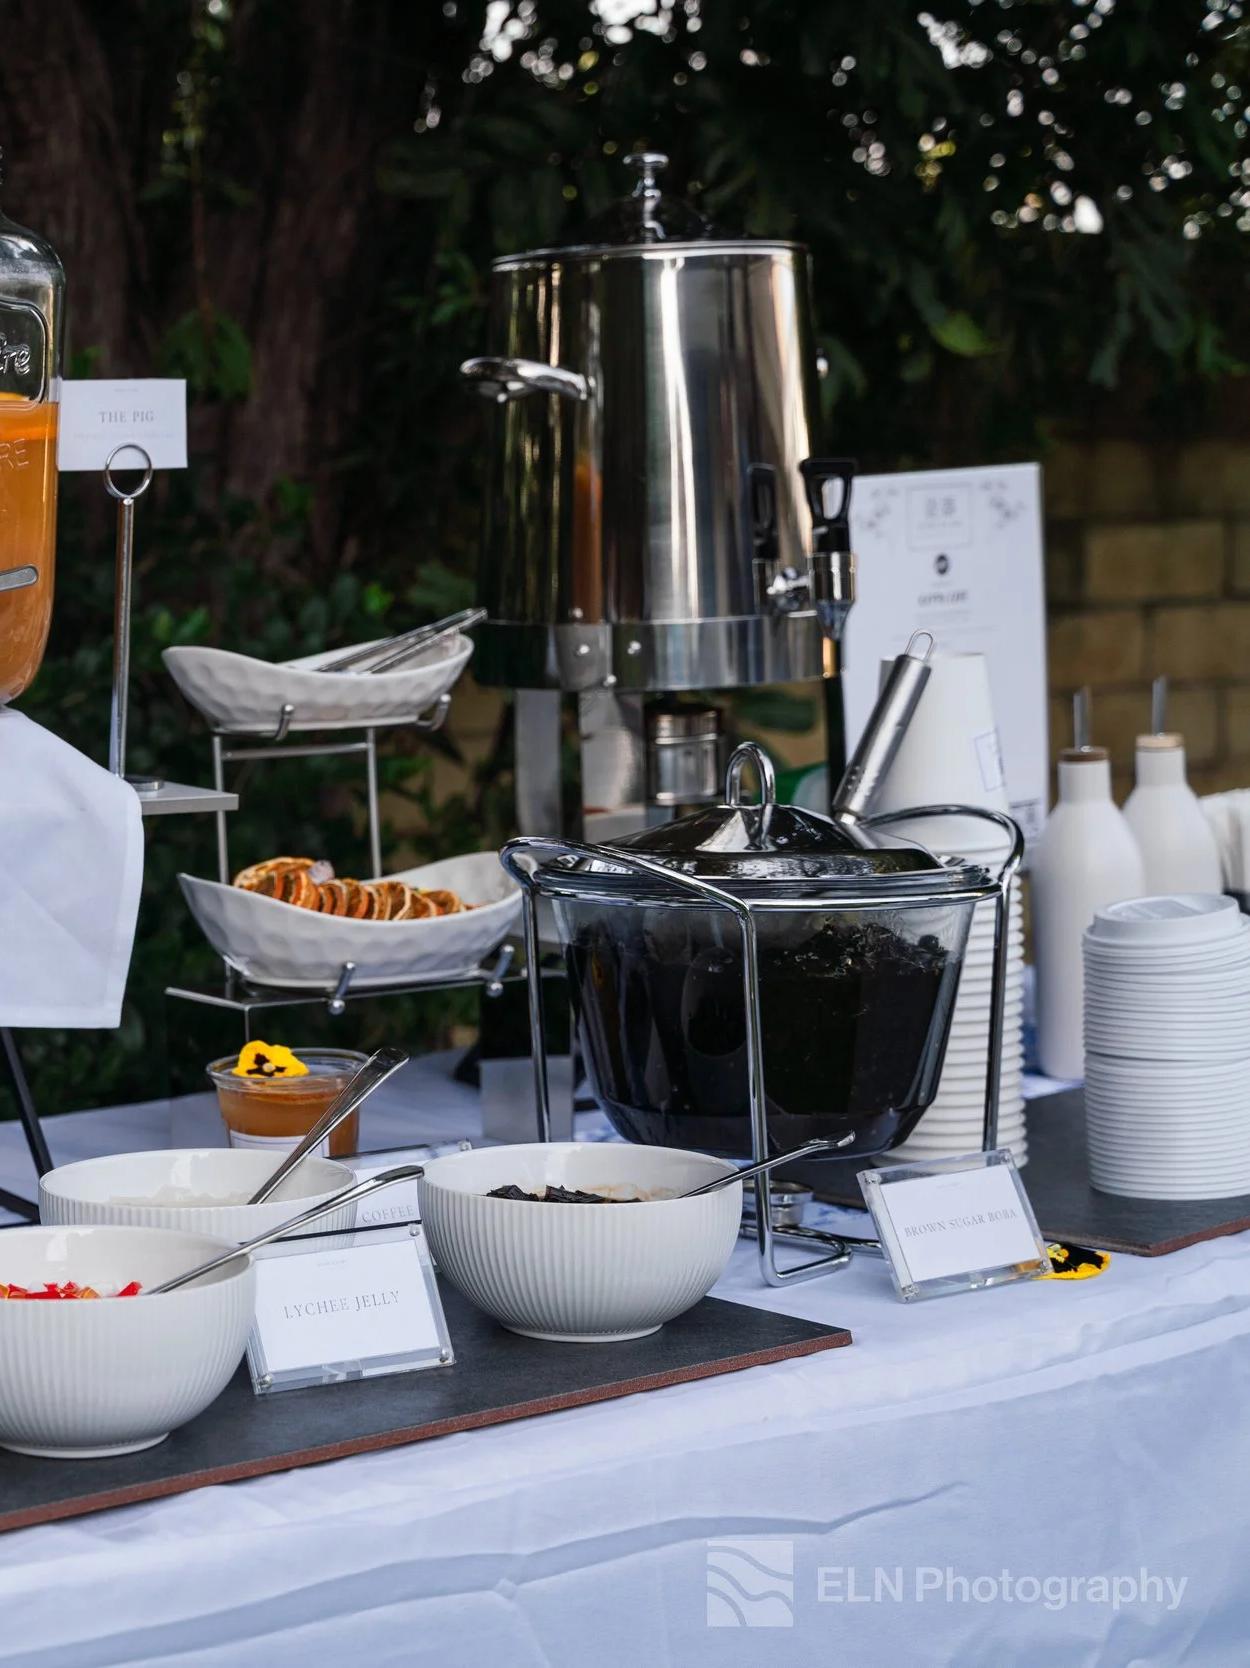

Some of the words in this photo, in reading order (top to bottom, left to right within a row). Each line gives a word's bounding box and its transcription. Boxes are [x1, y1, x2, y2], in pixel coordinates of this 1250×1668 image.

[99, 411, 127, 423] THE
[132, 411, 154, 423] PIG
[361, 1204, 415, 1223] COFFEE
[904, 1221, 947, 1237] BROWN
[949, 1214, 985, 1229] SUGAR
[988, 1208, 1018, 1222] BOBA
[283, 1297, 350, 1319] LYCHEE
[355, 1290, 400, 1311] JELLY
